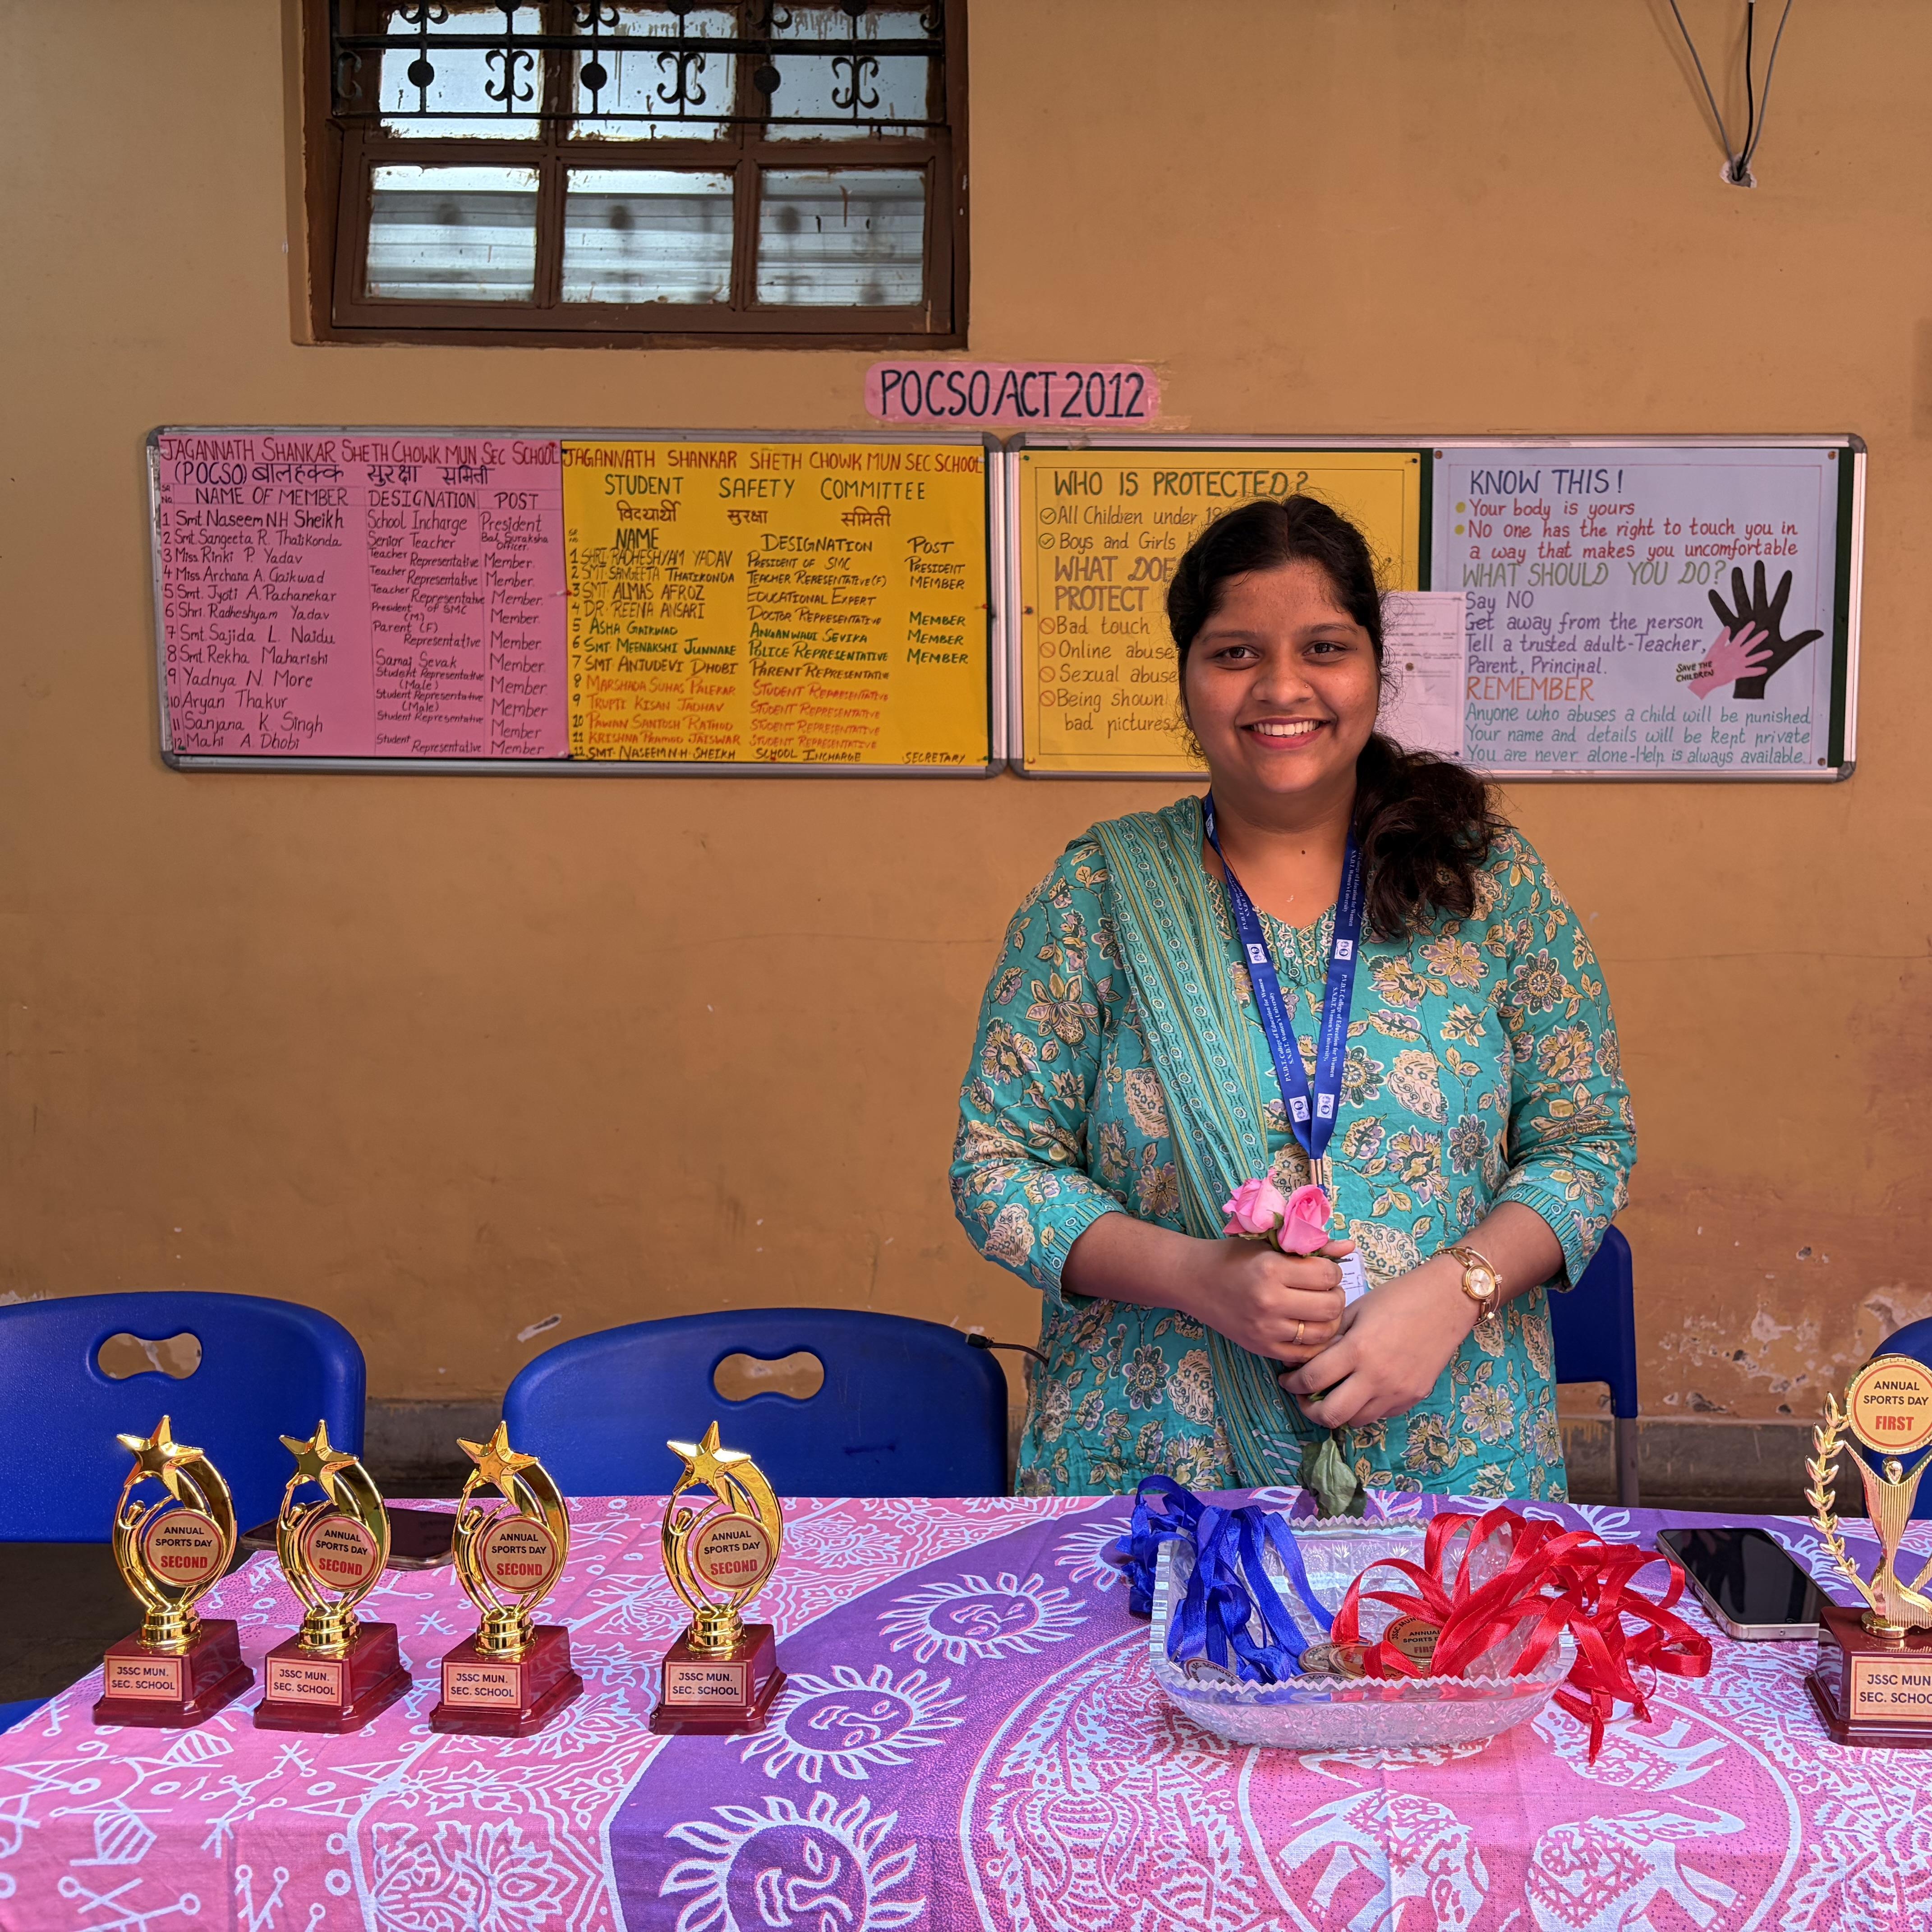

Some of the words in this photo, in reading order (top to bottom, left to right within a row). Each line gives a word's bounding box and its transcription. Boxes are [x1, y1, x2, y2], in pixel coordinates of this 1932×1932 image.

[881, 370, 990, 417] POCSO
[992, 370, 1057, 417] ACT
[1061, 372, 1145, 418] 2012
[161, 439, 254, 461] JAGANNATH
[262, 437, 335, 463] SHANKAR
[342, 439, 391, 463] SHETH
[392, 441, 441, 464] CHOWK
[446, 446, 476, 465] MUN
[482, 442, 505, 465] SEC
[512, 442, 559, 465] SCHOOL
[563, 448, 655, 468] JAGANNATH
[668, 450, 737, 469] SHANKAR
[750, 451, 801, 471] SHETH
[810, 451, 862, 471] CHOWK
[868, 453, 901, 471] MUN
[905, 454, 930, 472] SEC
[934, 454, 983, 474] SCHOOL
[175, 461, 247, 485] (POCSO)
[1471, 470, 1541, 494] KNOW
[605, 474, 684, 495] STUDENT
[719, 477, 795, 498] SAFETY
[821, 478, 925, 500] COMMITTEE
[1054, 470, 1102, 496] WHO
[1119, 472, 1138, 496] IS
[196, 488, 244, 504] NAME
[253, 487, 274, 504] OF
[279, 488, 349, 506] MEMBER
[368, 490, 476, 508] DESIGNATION
[494, 492, 538, 510] POST
[1057, 506, 1078, 524] All
[1084, 506, 1143, 524] Children
[1154, 506, 1197, 525] under
[1469, 498, 1506, 516] Your
[1513, 498, 1550, 520] body
[1564, 501, 1578, 515] is
[1587, 502, 1635, 520] yours
[368, 509, 406, 530] School
[412, 510, 467, 535] Incharge
[480, 511, 542, 532] President
[1468, 520, 1492, 538] No
[1504, 524, 1532, 538] one
[1543, 519, 1570, 538] has
[1580, 519, 1607, 537] the
[1617, 518, 1655, 540] right
[1664, 518, 1681, 535] to
[1689, 518, 1735, 535] touch
[1744, 522, 1773, 540] you
[1781, 521, 1798, 535] in
[615, 528, 659, 549] NAME
[760, 534, 872, 552] DESIGNATION
[907, 536, 955, 554] POST
[1060, 532, 1093, 554] Boys
[1104, 532, 1129, 549] and
[1139, 532, 1176, 550] Girls
[1470, 546, 1481, 559] a
[1491, 548, 1526, 564] way
[1538, 541, 1572, 558] that
[1582, 541, 1635, 558] makes
[1647, 547, 1674, 561] you
[1685, 538, 1798, 561] uncomfortable
[904, 556, 966, 574] PRESIDENT
[1054, 555, 1118, 581] WHAT
[1463, 563, 1520, 587] WHAT
[1528, 562, 1609, 586] SHOULD
[1628, 561, 1668, 585] YOU
[1678, 560, 1726, 585] DO?
[1055, 586, 1149, 612] PROTECT
[1466, 592, 1495, 613] Say
[1506, 591, 1533, 608] NO
[1057, 616, 1088, 635] Bad
[1101, 616, 1150, 635] touch
[1465, 612, 1495, 630] Get
[1507, 617, 1551, 635] away
[1558, 612, 1600, 633] from
[1610, 612, 1637, 630] the
[1647, 617, 1704, 635] person
[1059, 640, 1111, 658] Online
[1465, 634, 1493, 652] Tell
[1503, 639, 1512, 651] a
[1520, 635, 1577, 652] trusted
[376, 648, 413, 670] Samaj
[419, 651, 457, 669] Sevak
[1677, 664, 1696, 672] SAVE
[1060, 663, 1119, 682] Sexual
[1676, 670, 1713, 682] CHILDREN
[1466, 676, 1594, 701] REMEMBER
[182, 692, 225, 714] Aryan
[235, 690, 288, 709] Thakur
[1057, 688, 1101, 713] Being
[1111, 689, 1164, 707] shown
[1465, 703, 1518, 726] Anyone
[1527, 704, 1559, 721] who
[1567, 705, 1616, 722] abuses
[1625, 708, 1634, 721] a
[1640, 704, 1674, 722] child
[1683, 706, 1711, 722] will
[1720, 707, 1738, 722] be
[903, 752, 966, 764] SECRETARY
[1334, 1021, 1342, 1047] Education
[1874, 1381, 1920, 1391] ANNUAL
[1863, 1395, 1905, 1405] SPORTS
[1908, 1396, 1929, 1405] DAY
[1876, 1416, 1914, 1431] FIRST
[164, 1526, 204, 1535] ANNUAL
[711, 1531, 752, 1541] ANNUAL
[155, 1538, 192, 1548] SPORTS
[194, 1538, 213, 1547] DAY
[703, 1544, 740, 1555] SPORTS
[742, 1541, 761, 1551] DAY
[161, 1555, 208, 1569] SECOND
[710, 1559, 758, 1575] SECOND
[116, 1667, 141, 1677] JSSC
[143, 1667, 169, 1677] MUN.
[678, 1672, 704, 1682] JSSC
[706, 1673, 732, 1682] MUN.
[111, 1679, 133, 1689] SEC.
[135, 1679, 175, 1690] SCHOOL
[672, 1686, 695, 1695] SEC.
[697, 1687, 740, 1696] SCHOOL
